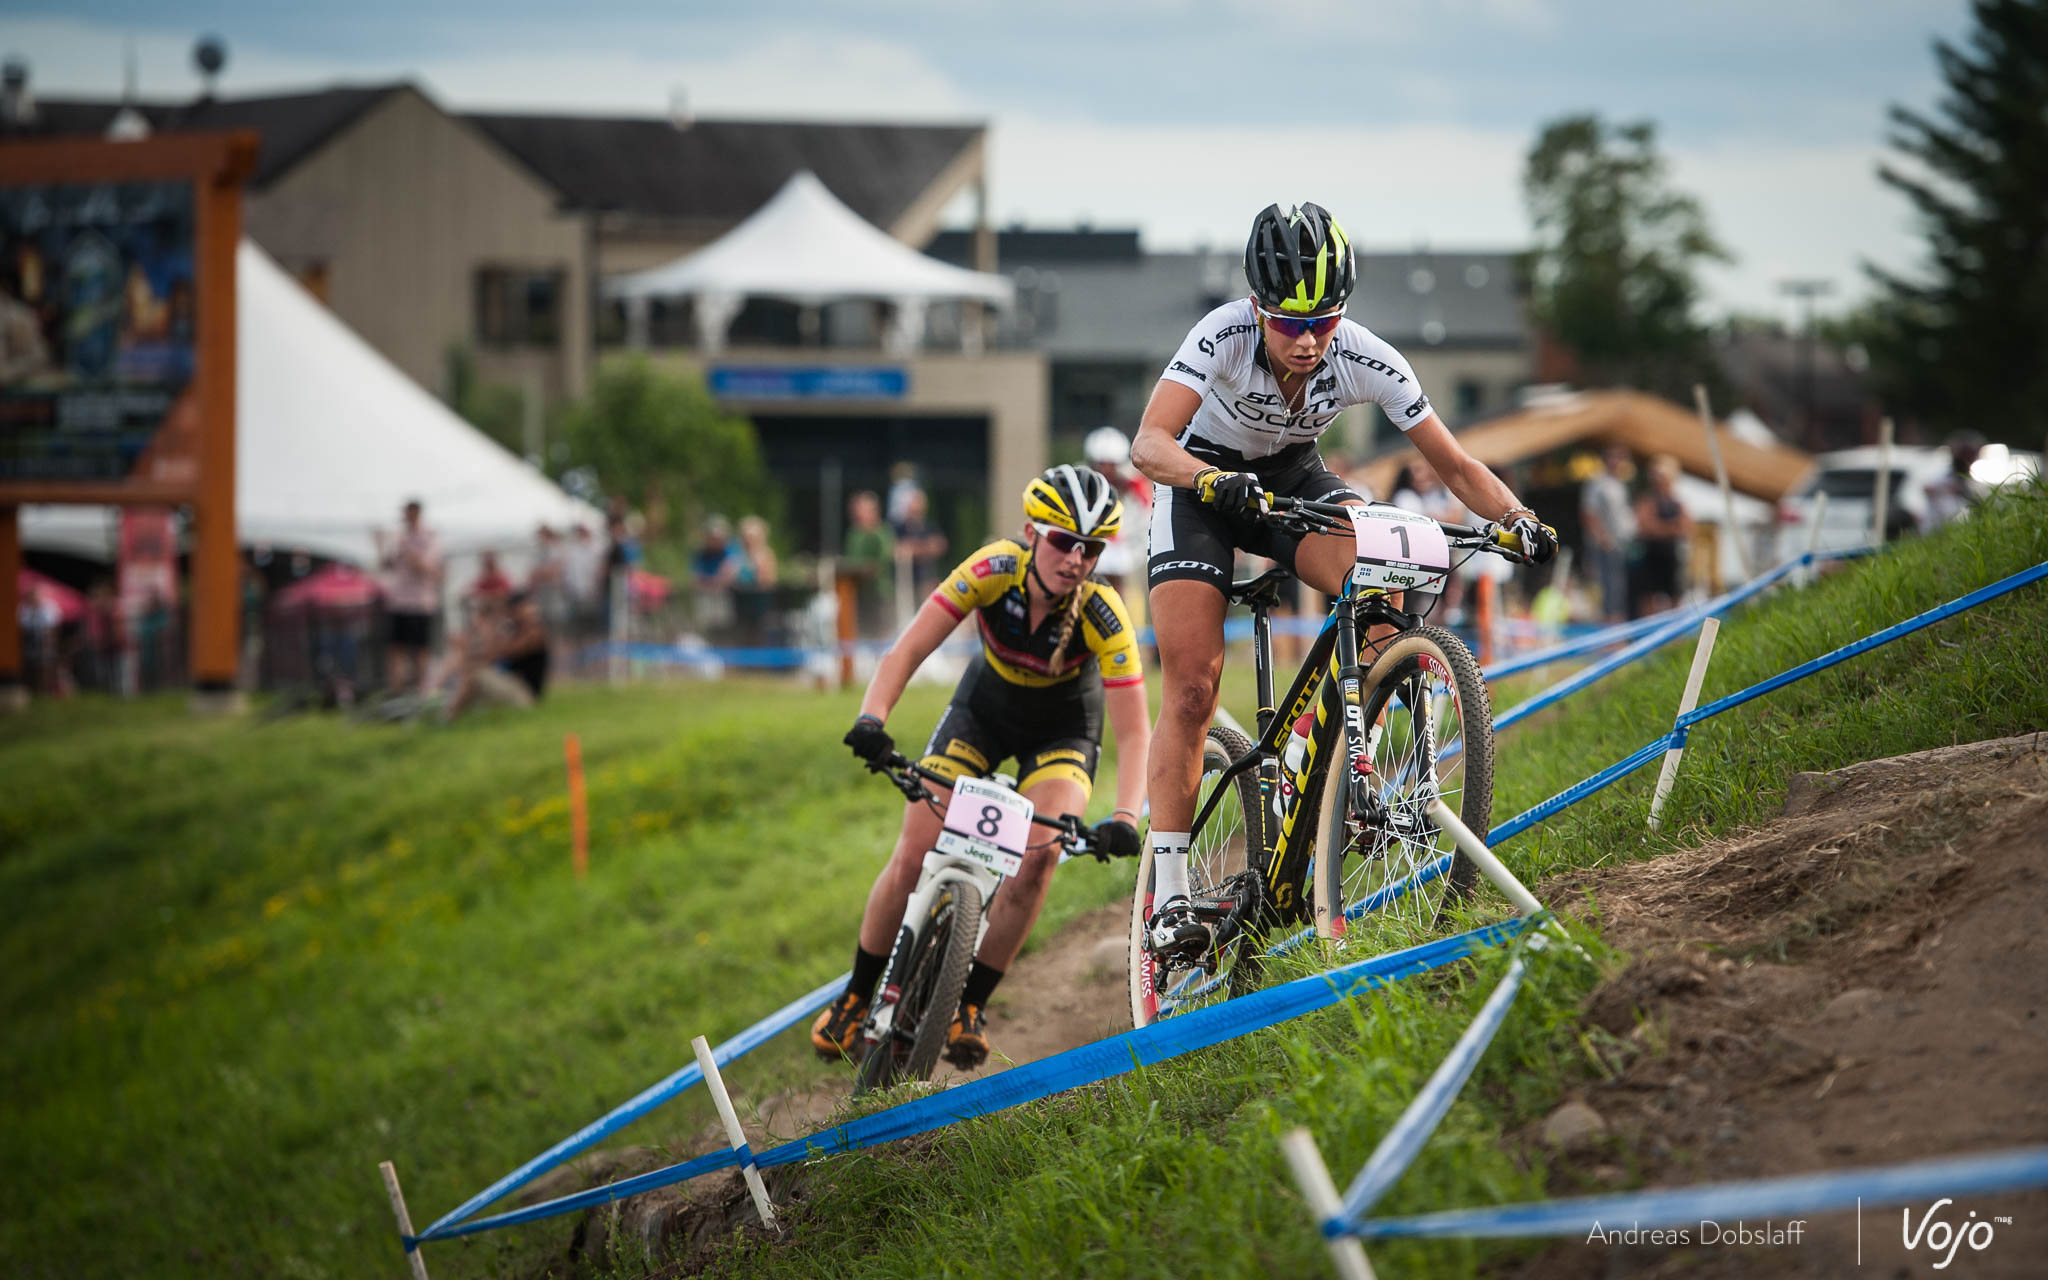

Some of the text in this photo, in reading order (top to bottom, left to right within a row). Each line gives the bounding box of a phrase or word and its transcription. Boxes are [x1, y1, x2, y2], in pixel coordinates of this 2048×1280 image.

[1215, 324, 1260, 345] SCOTT
[1339, 349, 1410, 384] SCOTT
[1241, 391, 1341, 416] SCTT
[1390, 525, 1411, 559] 1
[1150, 560, 1224, 578] SCOTT
[1383, 571, 1416, 589] Jeep
[1273, 666, 1321, 750] SCOTT
[1346, 704, 1362, 732] DT
[976, 805, 1003, 837] 8
[1140, 952, 1153, 999] SWISS
